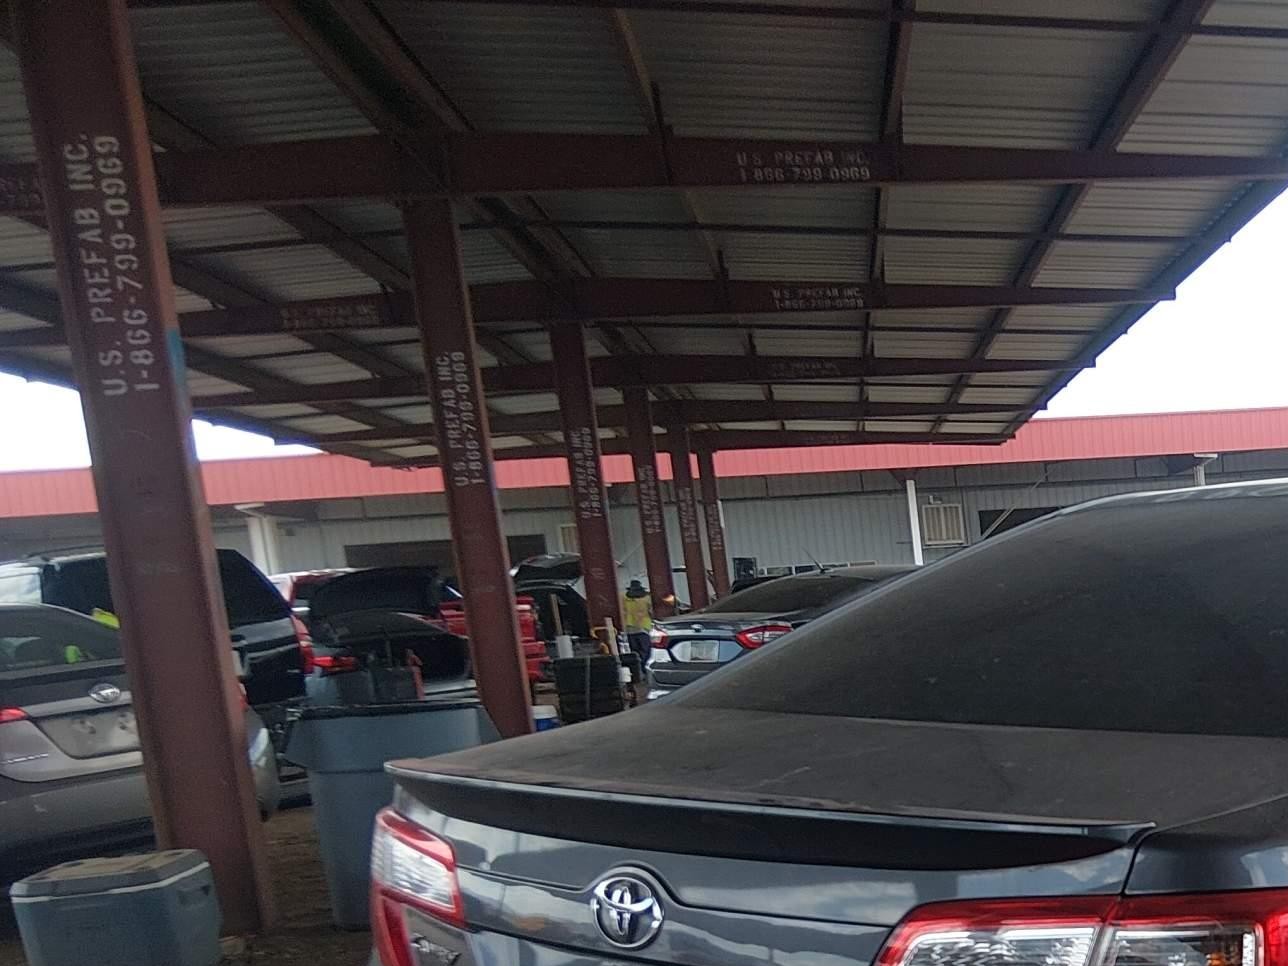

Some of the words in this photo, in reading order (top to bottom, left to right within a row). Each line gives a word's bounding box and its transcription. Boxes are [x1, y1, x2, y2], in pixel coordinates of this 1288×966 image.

[63, 133, 96, 192] INC.
[75, 208, 115, 324] PREFAB
[94, 135, 160, 393] 1-866-799-0969
[99, 340, 129, 397] U.S.
